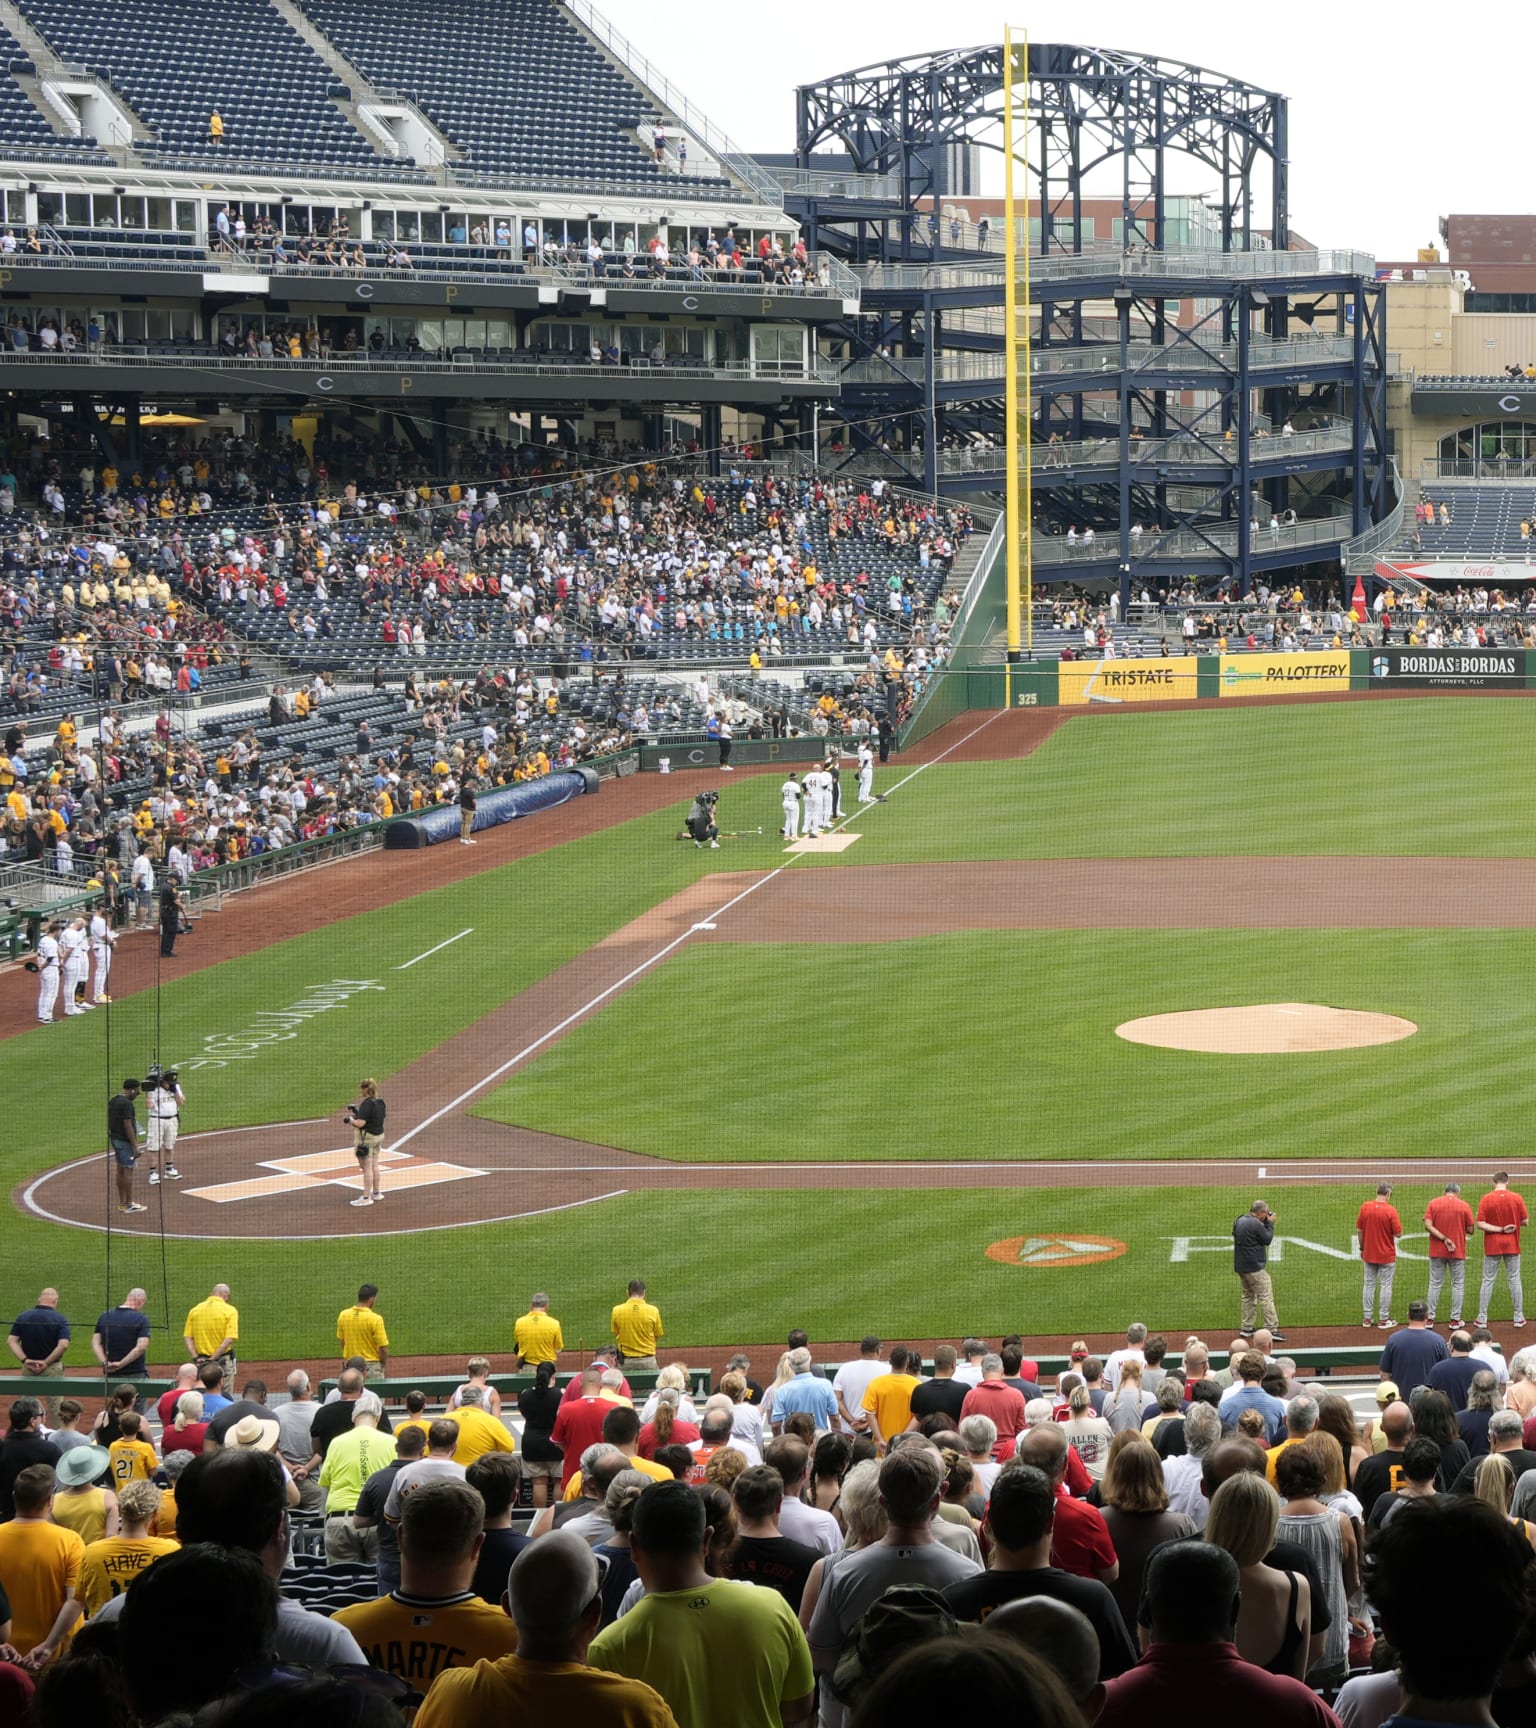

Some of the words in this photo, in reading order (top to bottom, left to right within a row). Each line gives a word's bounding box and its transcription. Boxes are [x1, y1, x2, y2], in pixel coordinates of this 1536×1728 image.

[1265, 667, 1286, 682] PA
[1287, 664, 1348, 681] LOTTERY
[1400, 656, 1454, 673] BORDAS
[1461, 657, 1515, 673] BORDAS
[1102, 669, 1174, 686] TRISTATE
[1018, 694, 1038, 705] 325
[116, 1459, 133, 1479] 21
